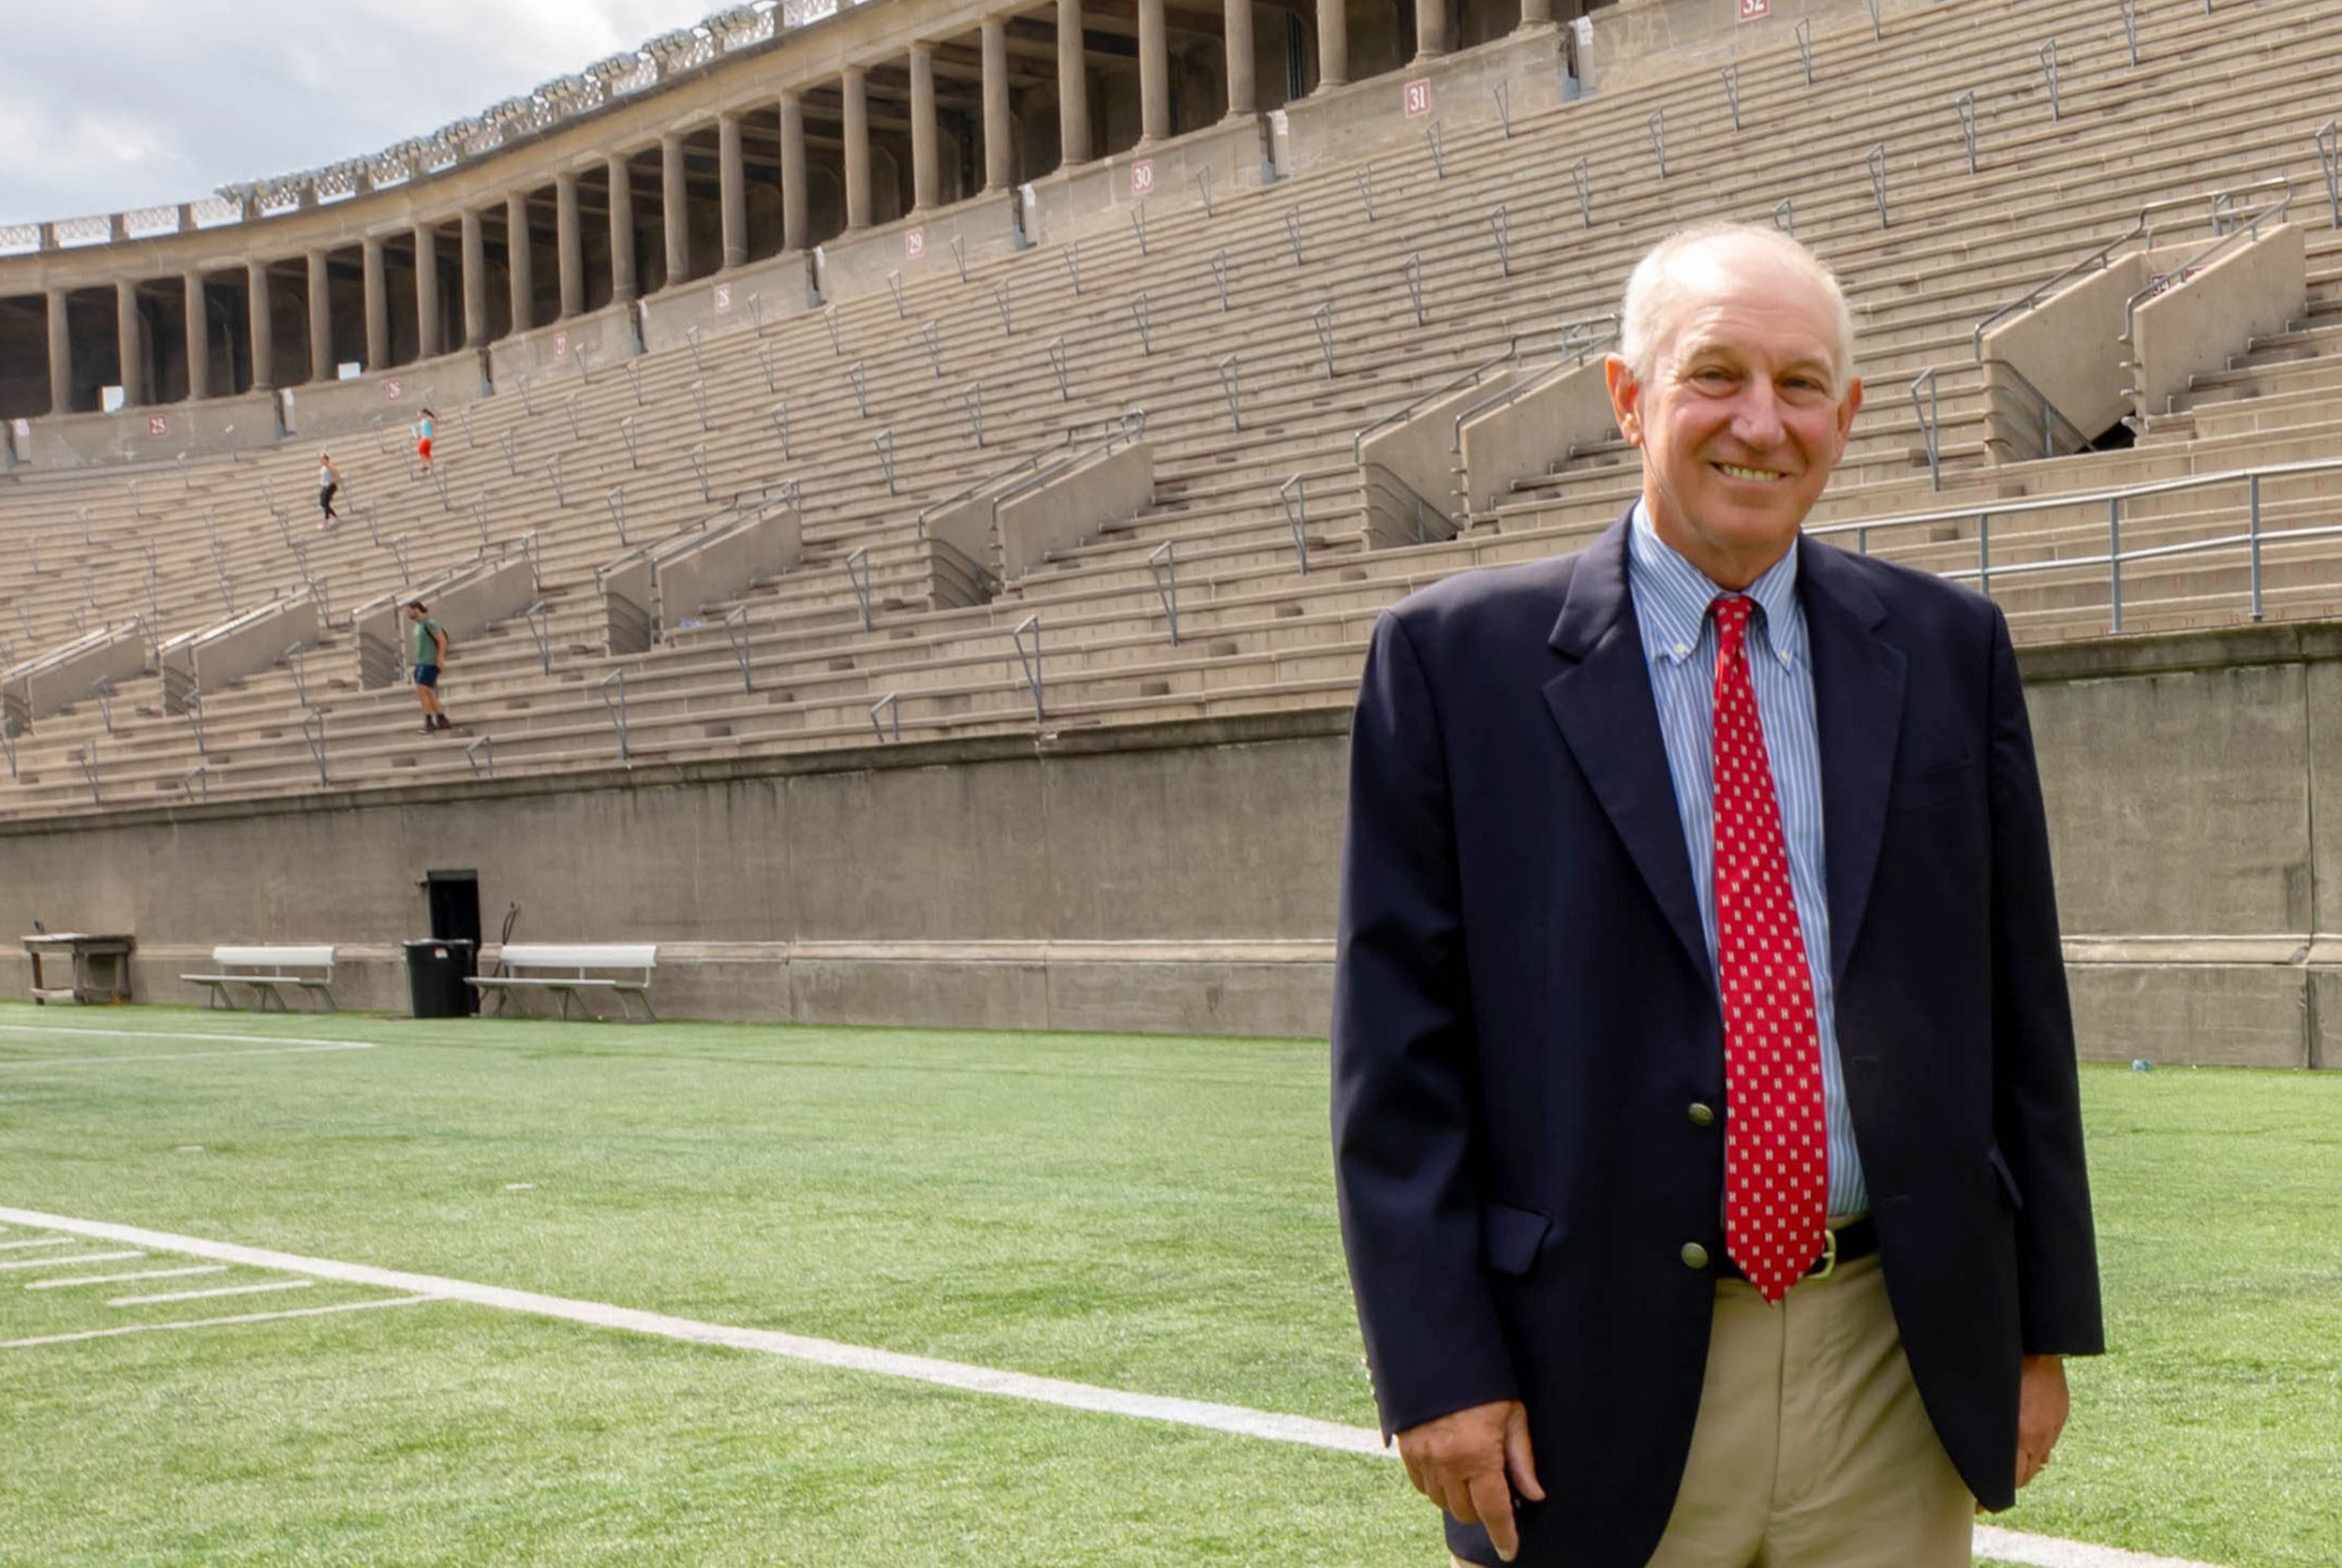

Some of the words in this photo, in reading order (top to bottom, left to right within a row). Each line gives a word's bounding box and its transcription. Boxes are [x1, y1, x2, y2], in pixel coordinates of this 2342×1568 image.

[1409, 85, 1426, 111] 31
[1134, 165, 1151, 190] 30
[909, 232, 922, 255] 29
